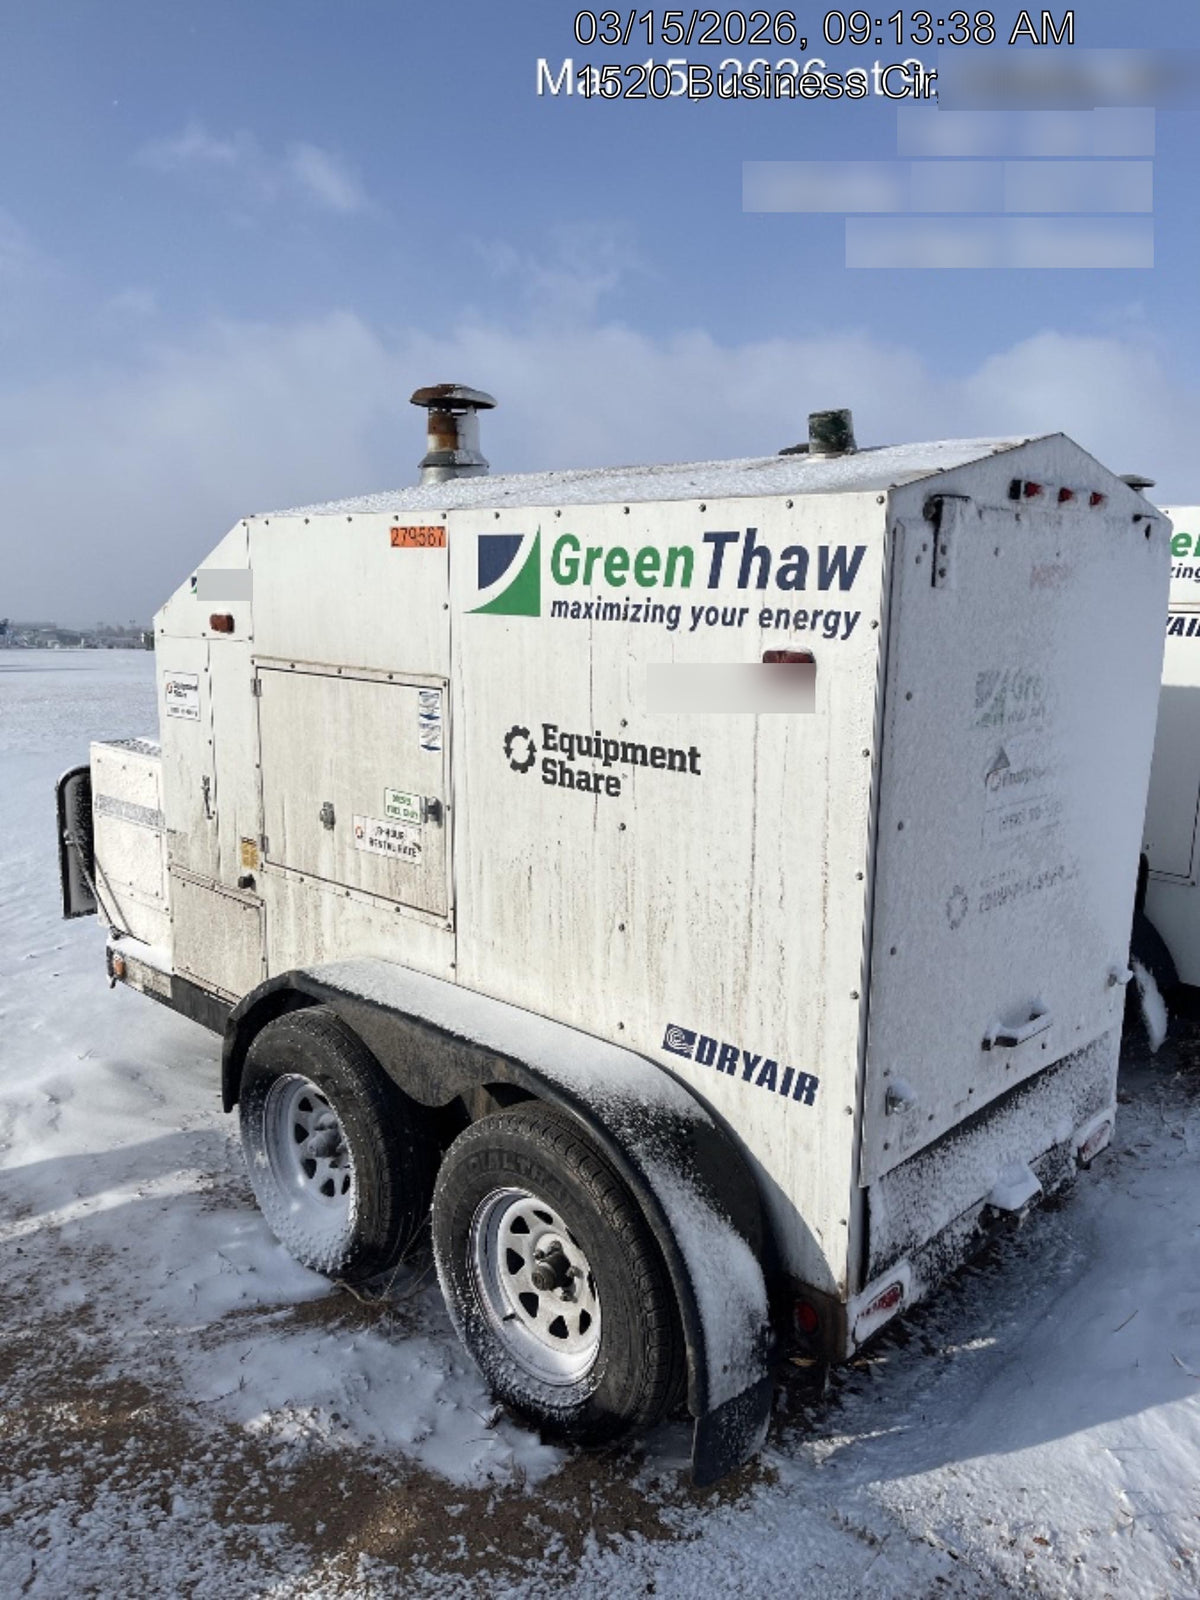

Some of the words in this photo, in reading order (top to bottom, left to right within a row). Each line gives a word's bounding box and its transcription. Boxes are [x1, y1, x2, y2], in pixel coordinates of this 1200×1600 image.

[550, 594, 682, 632] maximizing
[689, 605, 749, 632] your
[758, 607, 861, 641] energy
[541, 723, 702, 776] Equipment
[541, 757, 622, 798] Share
[695, 1034, 819, 1107] DRYAIR
